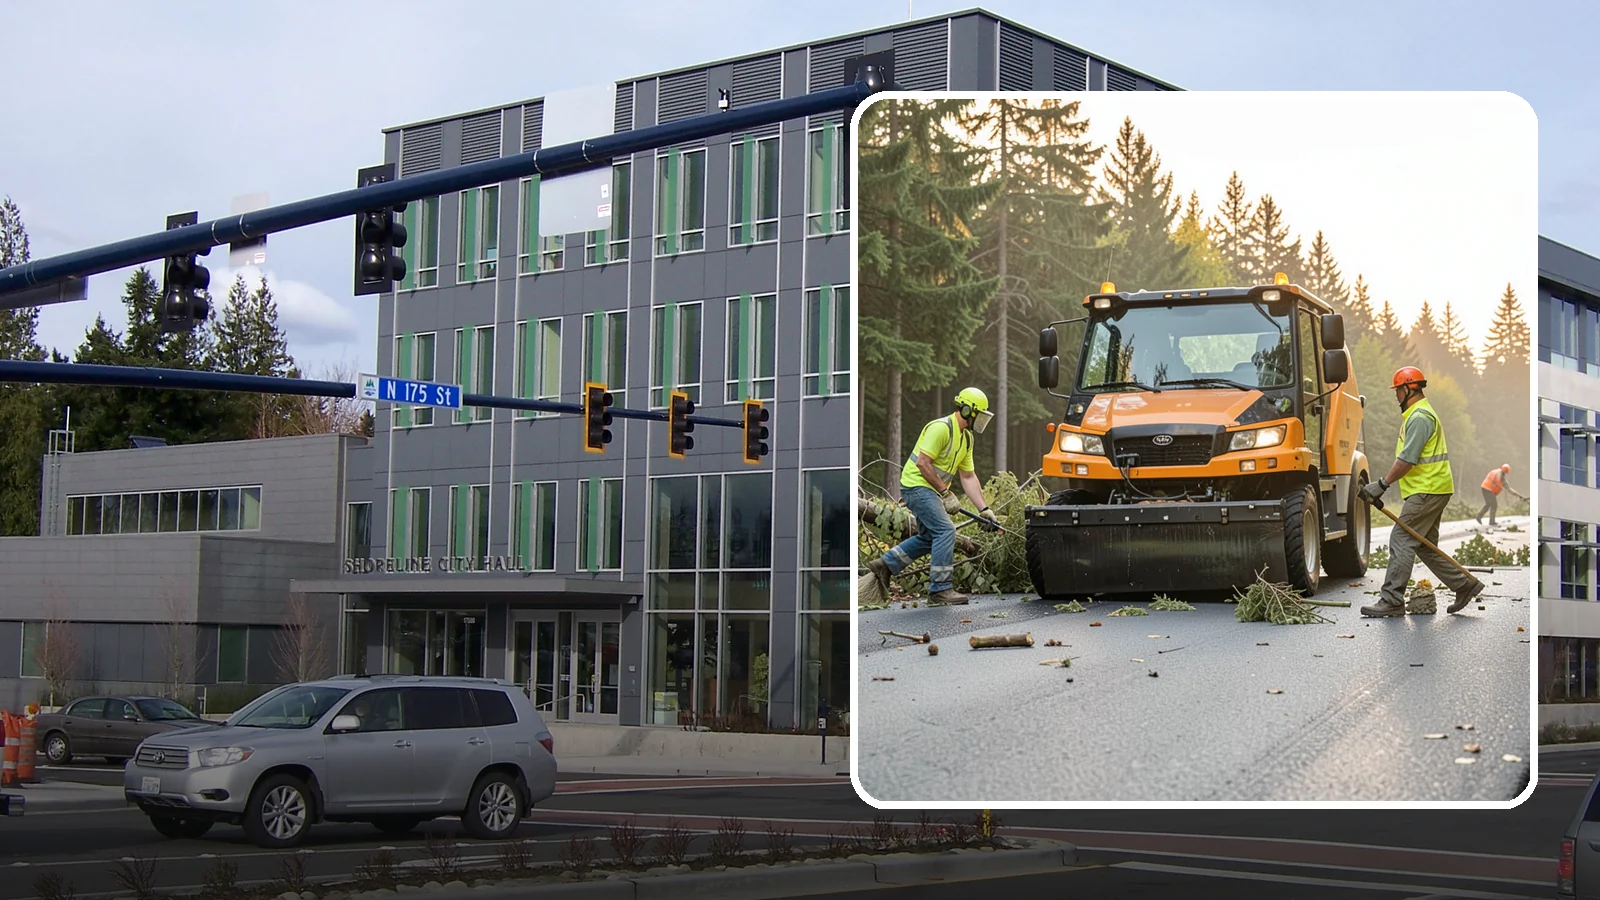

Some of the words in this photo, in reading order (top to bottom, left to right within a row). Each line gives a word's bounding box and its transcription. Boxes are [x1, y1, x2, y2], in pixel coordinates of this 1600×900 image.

[387, 381, 396, 399] N
[405, 382, 427, 403] 175
[436, 386, 451, 406] St
[345, 557, 432, 574] SHORELINE
[438, 556, 475, 573] CITY
[483, 555, 525, 572] HALL
